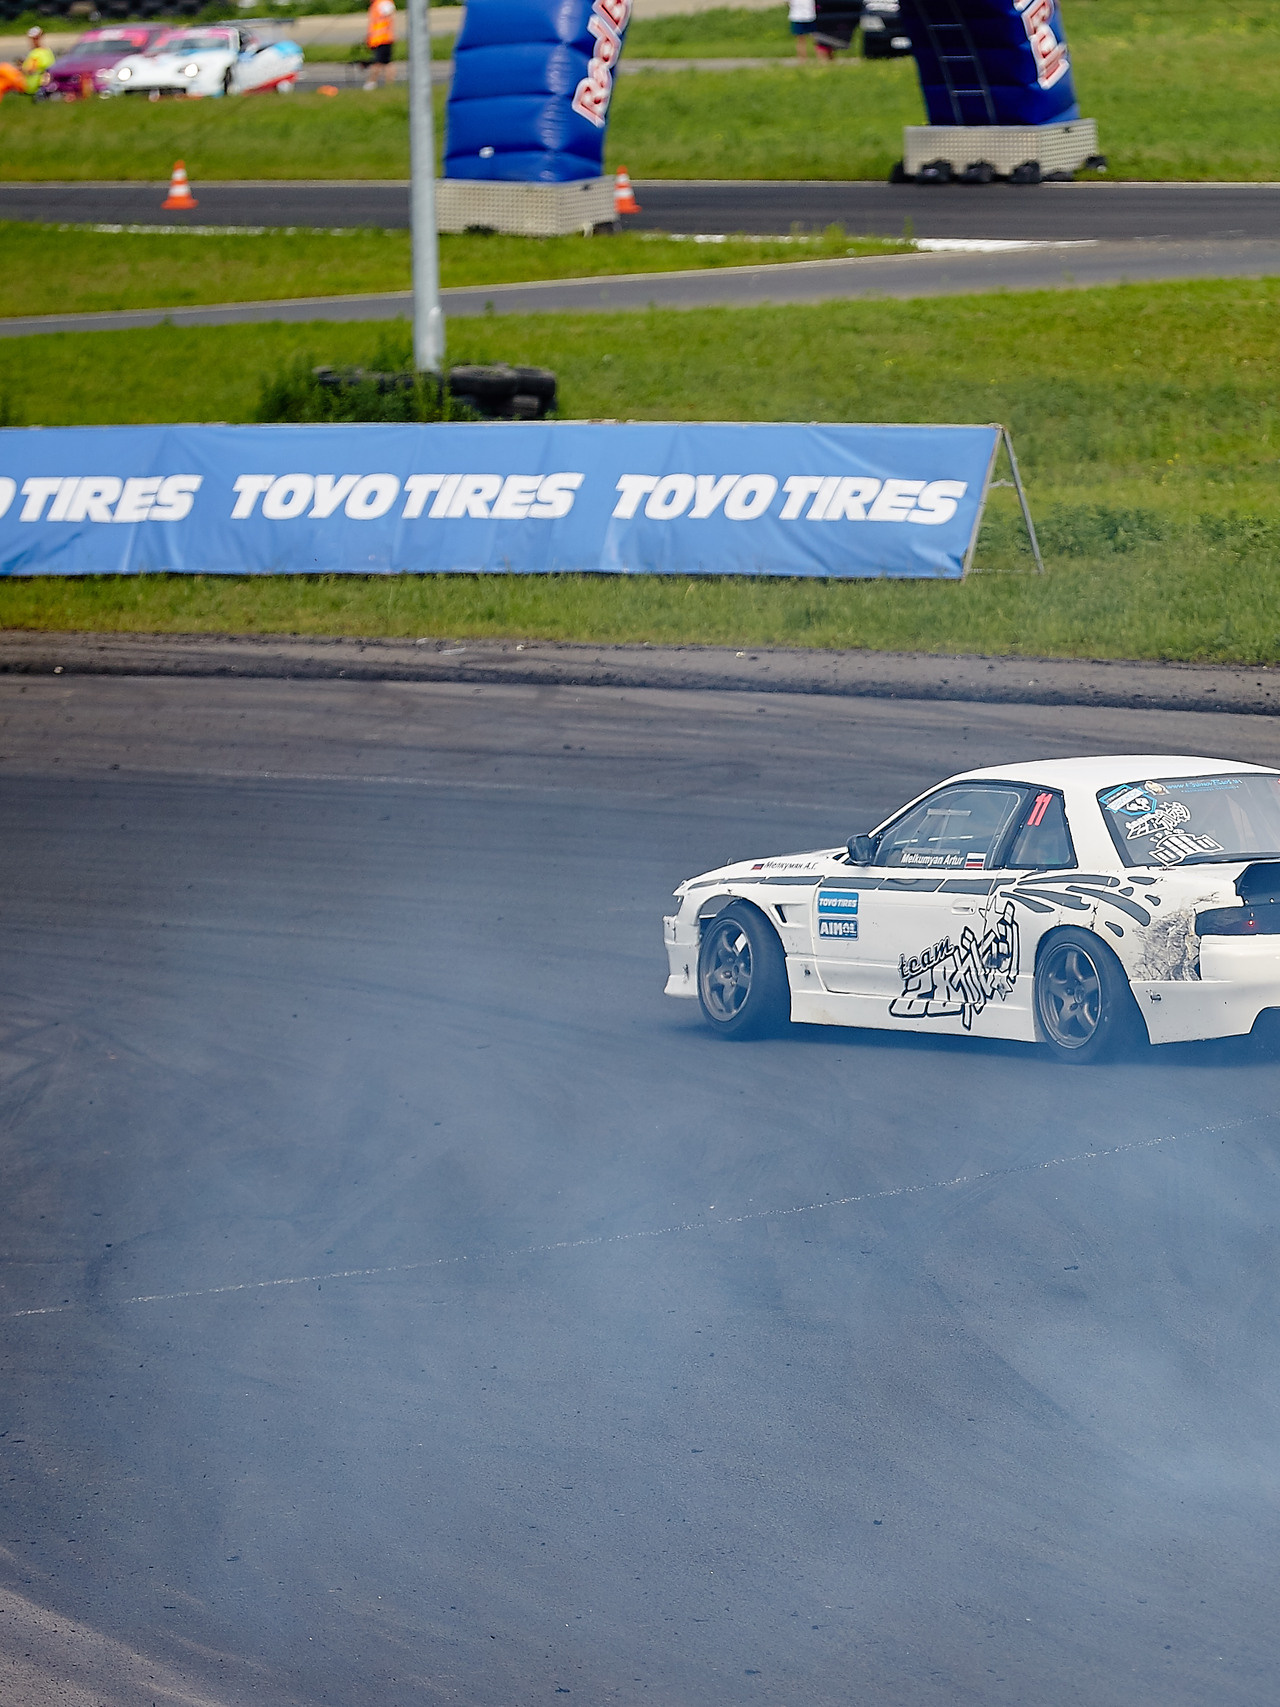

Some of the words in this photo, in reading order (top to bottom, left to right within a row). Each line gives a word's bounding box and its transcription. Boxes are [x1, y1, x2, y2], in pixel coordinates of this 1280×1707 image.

[572, 13, 622, 128] Red
[19, 474, 203, 523] TIRES
[230, 473, 400, 520] TOYO
[402, 472, 586, 520] TIRES
[612, 473, 778, 521] TOYO
[779, 475, 968, 526] TIRES
[1027, 793, 1053, 827] 11
[901, 853, 944, 867] Melkumyan
[943, 854, 965, 866] Artur
[819, 898, 836, 908] TOYO
[835, 898, 858, 908] TIRES
[820, 921, 858, 936] AIMOL
